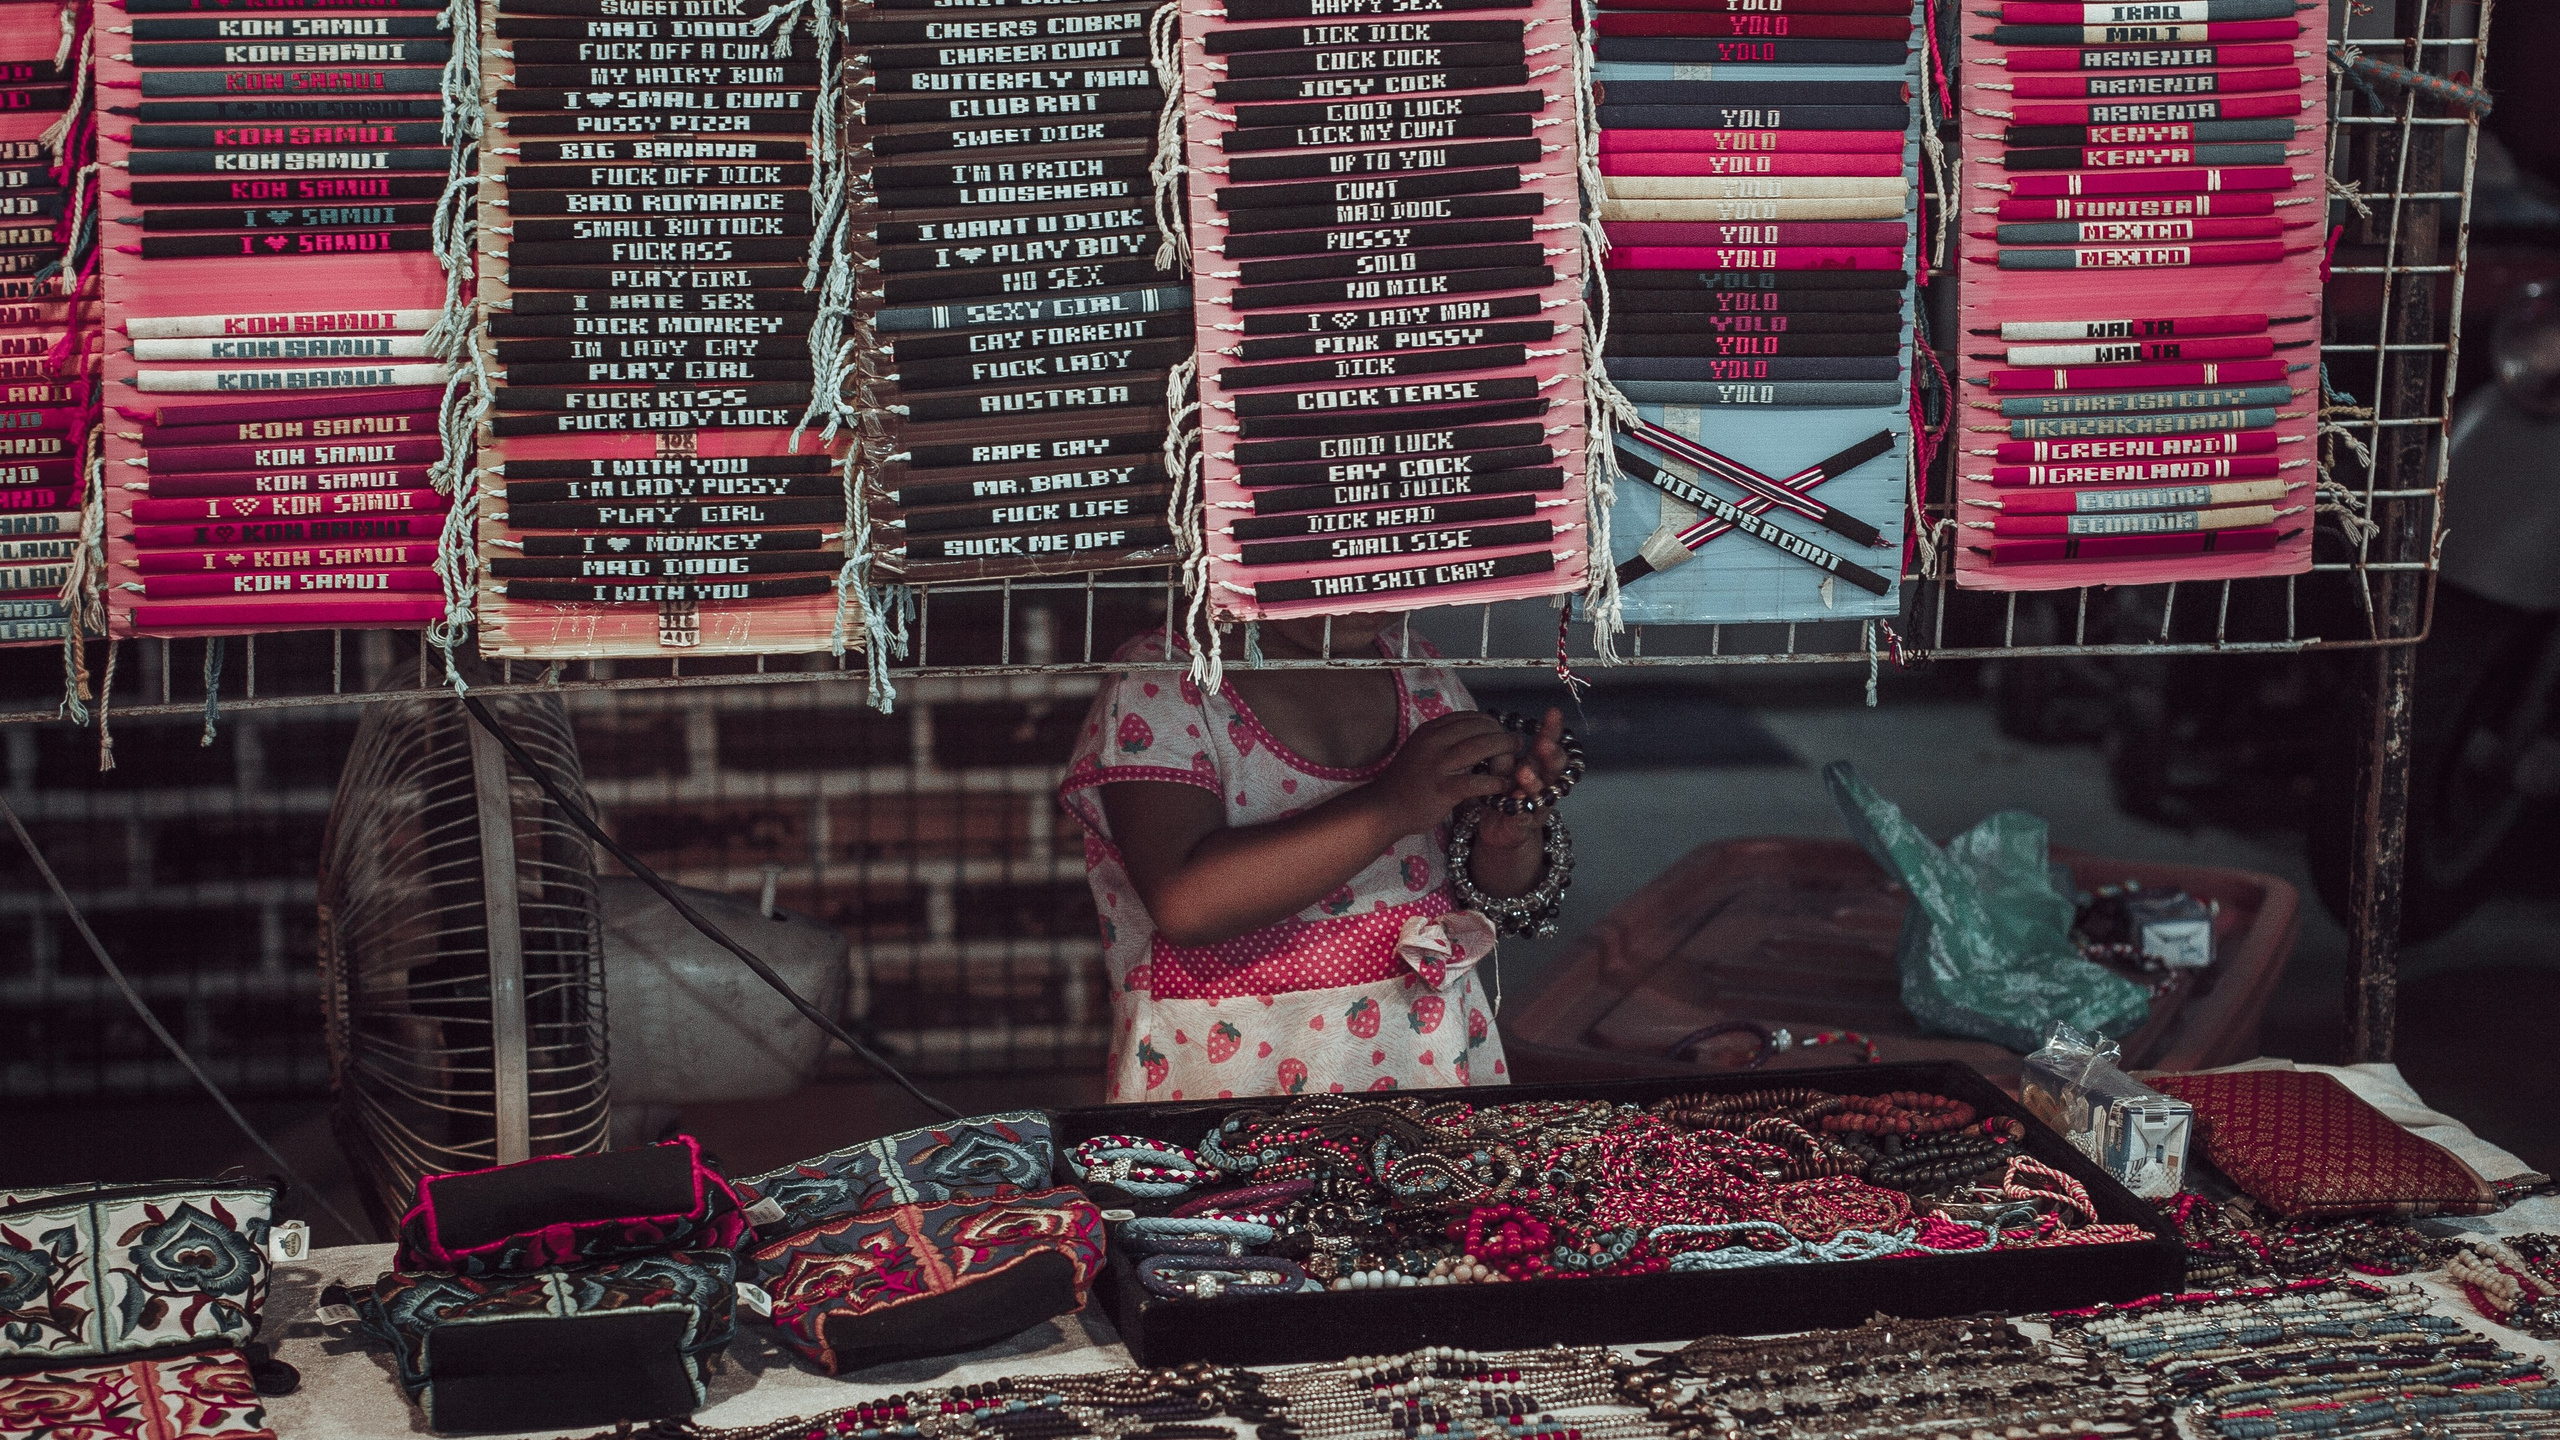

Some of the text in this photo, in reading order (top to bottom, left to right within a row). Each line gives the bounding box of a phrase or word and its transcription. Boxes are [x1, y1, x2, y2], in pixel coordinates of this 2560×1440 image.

[2111, 7, 2183, 21] IRAQ
[219, 19, 389, 36] KOH SAMUI
[926, 13, 1141, 39] CHEERS COBRA
[1303, 24, 1430, 45] LICK DICK
[1730, 16, 1789, 35] YOLO
[2106, 27, 2180, 42] MALI
[225, 44, 406, 62] KOH SAMUI
[1316, 49, 1441, 71] COCK COCK
[2084, 48, 2213, 67] ARMENIA
[591, 67, 783, 85] MY HAIRY BUM
[912, 70, 1149, 90] BUTTERFLY MAN
[1386, 74, 1446, 93] COCK
[2091, 76, 2213, 94] ARMENIA
[564, 91, 803, 109] I SMALL CUNT
[950, 93, 1100, 118] CLUB RAT
[1722, 109, 1780, 128] YOLO
[2092, 102, 2216, 121] ARMENIA
[577, 115, 750, 132] PUSSY PIZZA
[215, 126, 397, 145] KOH SAMUI
[953, 123, 1104, 147] SWEET DICK
[2091, 125, 2189, 144] KENYA
[559, 142, 756, 159] BIG BANANA
[1330, 149, 1446, 172] UP TO YOU
[2086, 149, 2190, 166] KENYA
[215, 152, 389, 170] KOH SAMUI
[1709, 156, 1771, 174] YOLO
[591, 166, 781, 185] FUCK OFF DICK
[960, 181, 1128, 203] LOOSEHEAD
[1336, 180, 1398, 201] CUNT
[566, 193, 784, 212] BAD ROMANCE
[2074, 200, 2192, 217] TUNISIA
[244, 208, 395, 227] I SAMUI
[918, 209, 1143, 241] I WANT U DICK
[574, 217, 783, 239] SMALL BUTTOCK
[1720, 225, 1778, 245] YOLO
[2084, 223, 2188, 240] MEXICO
[240, 233, 391, 253] I SAMUI
[1327, 229, 1410, 249] PUSSY
[935, 234, 1146, 267] I PLAY BOY
[1717, 249, 1776, 268] YOLO
[2081, 249, 2186, 265] MEXICO
[1357, 253, 1416, 274] SOLO
[612, 270, 751, 288] PLAY GIRL
[1002, 265, 1104, 292] NO SEX
[1346, 276, 1447, 299] NO MILK
[573, 293, 754, 311] I HATE SEX
[967, 296, 1129, 323] SEXY GIRL
[224, 314, 397, 333] KOH SAMUI
[573, 317, 783, 335] DICK MONKEY
[1308, 302, 1490, 331] I LADY MAN
[970, 331, 1024, 352] GAY
[1315, 329, 1483, 353] PINK PUSSY
[1716, 336, 1778, 355] YOLO
[589, 361, 754, 380] PLAY GIRL
[972, 350, 1132, 380] FUCK LADY
[1335, 357, 1395, 378] DICK
[1711, 360, 1768, 378] YOLO
[218, 369, 395, 389] KOH SAMUI
[980, 386, 1128, 412] AUSTRIA
[1297, 382, 1479, 410] COCK TEASE
[1718, 384, 1774, 403] YOLO
[239, 417, 412, 440] KOH SAMUI
[558, 409, 788, 430] FUCK LADY LOCK
[972, 439, 1109, 461] RAPE GAY
[1395, 431, 1454, 453] LUCK
[2052, 438, 2223, 459] GREENLAND
[591, 458, 748, 476] I WITH YOU
[2049, 462, 2210, 482] GREENLAND
[256, 471, 398, 492] KOH SAMUI
[621, 478, 695, 496] LADY
[702, 478, 790, 495] PUSSY
[206, 493, 413, 518] I KOH SAMUI
[992, 499, 1128, 523] FUCK LIFE
[1307, 506, 1435, 533] DICK HEAD
[583, 533, 762, 553] I MONKEY
[944, 531, 1125, 556] SUCK ME OFF
[1760, 524, 1779, 543] A
[1777, 533, 1842, 571] CUNT
[202, 546, 408, 569] I KOH SAMUI
[583, 559, 650, 576] MAD
[234, 573, 389, 592] KOH SAMUI
